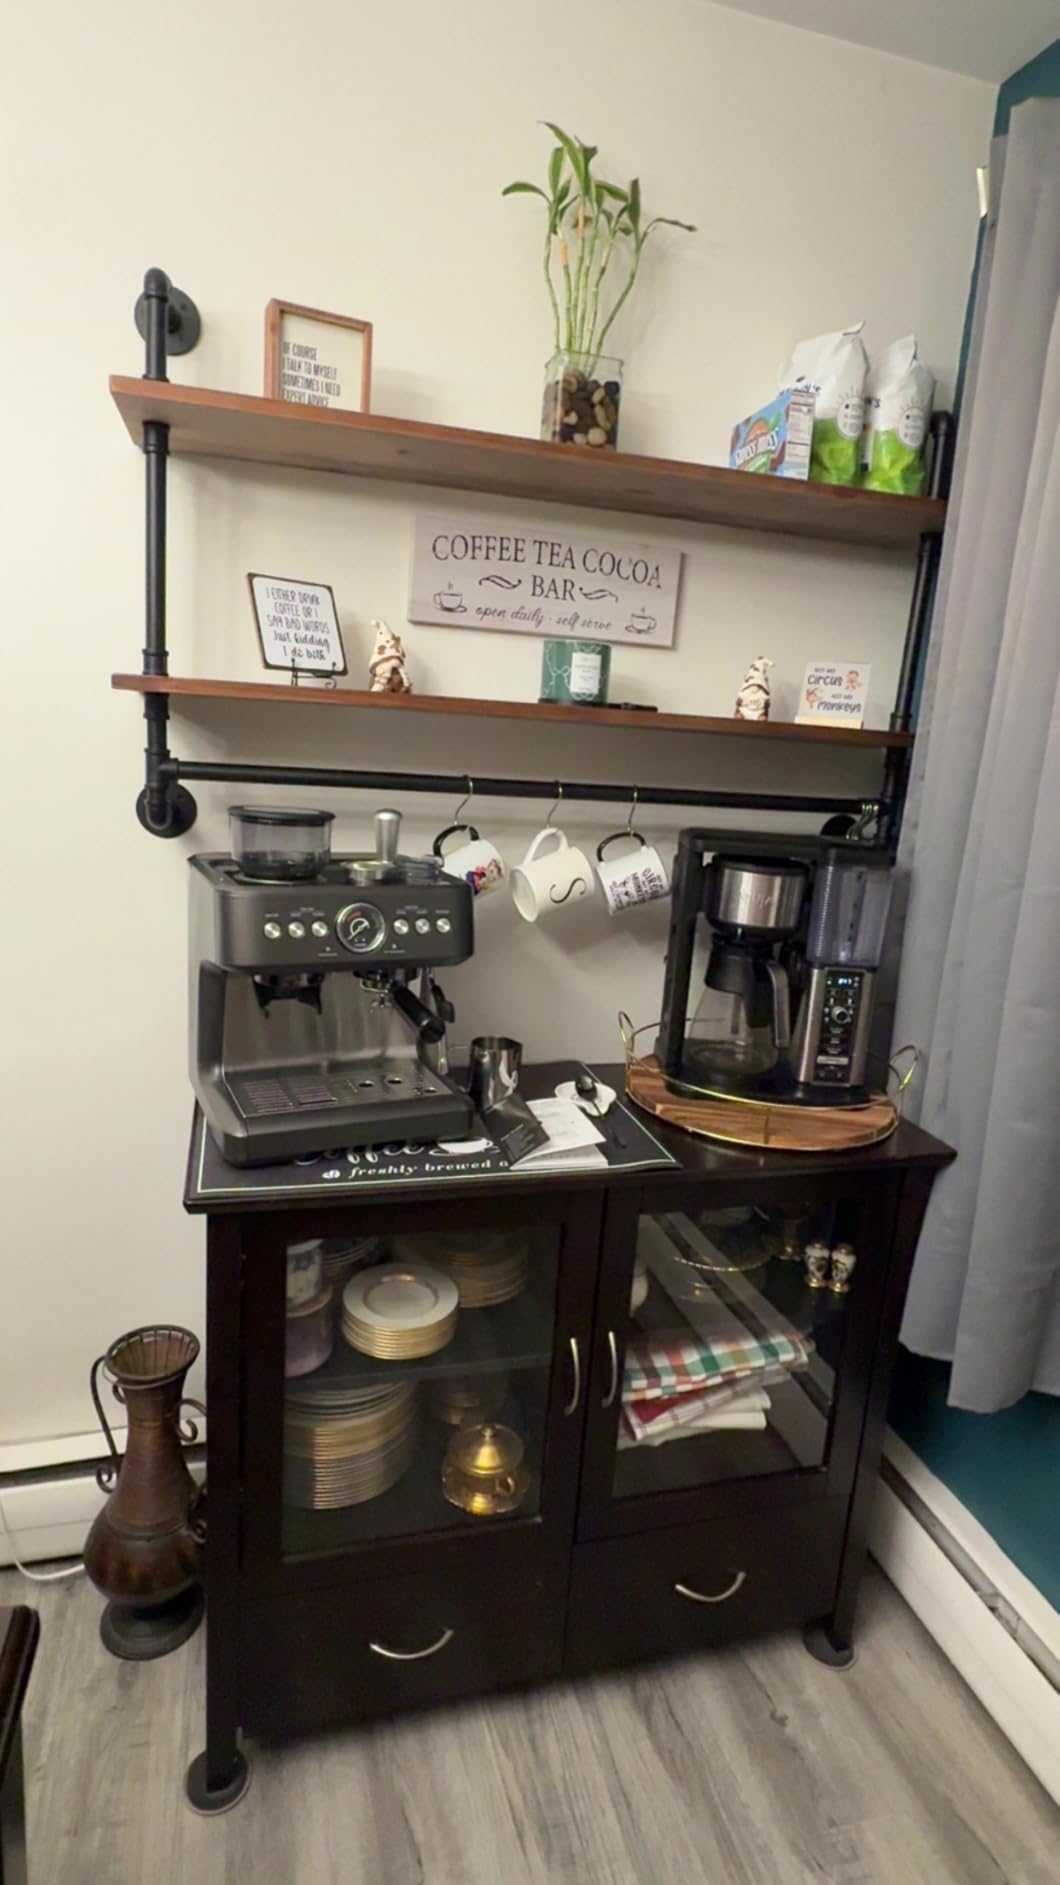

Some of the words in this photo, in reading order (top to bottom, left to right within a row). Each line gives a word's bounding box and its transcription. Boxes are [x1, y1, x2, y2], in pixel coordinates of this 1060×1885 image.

[292, 344, 316, 361] COURSE
[287, 358, 301, 371] TALK
[304, 361, 312, 375] TO
[282, 374, 319, 392] SOMETIMES
[325, 383, 341, 397] NEED
[282, 389, 305, 404] EXPERT
[431, 534, 526, 563] COFFEE
[533, 538, 576, 570] TEA
[582, 547, 662, 589] COCOA
[271, 587, 296, 602] EITHER
[530, 574, 576, 601] BAR
[274, 602, 300, 617] COFFEE
[302, 605, 314, 619] OR
[475, 604, 506, 622] open
[510, 605, 544, 628] daily
[556, 612, 579, 631] self
[582, 616, 613, 630] serve
[285, 617, 301, 631] BAD
[303, 619, 331, 635] WORDS
[290, 646, 304, 658] do
[808, 675, 843, 686] Circus
[817, 701, 861, 713] Monkeys
[348, 1164, 418, 1178] freshly
[424, 1160, 492, 1172] brewed
